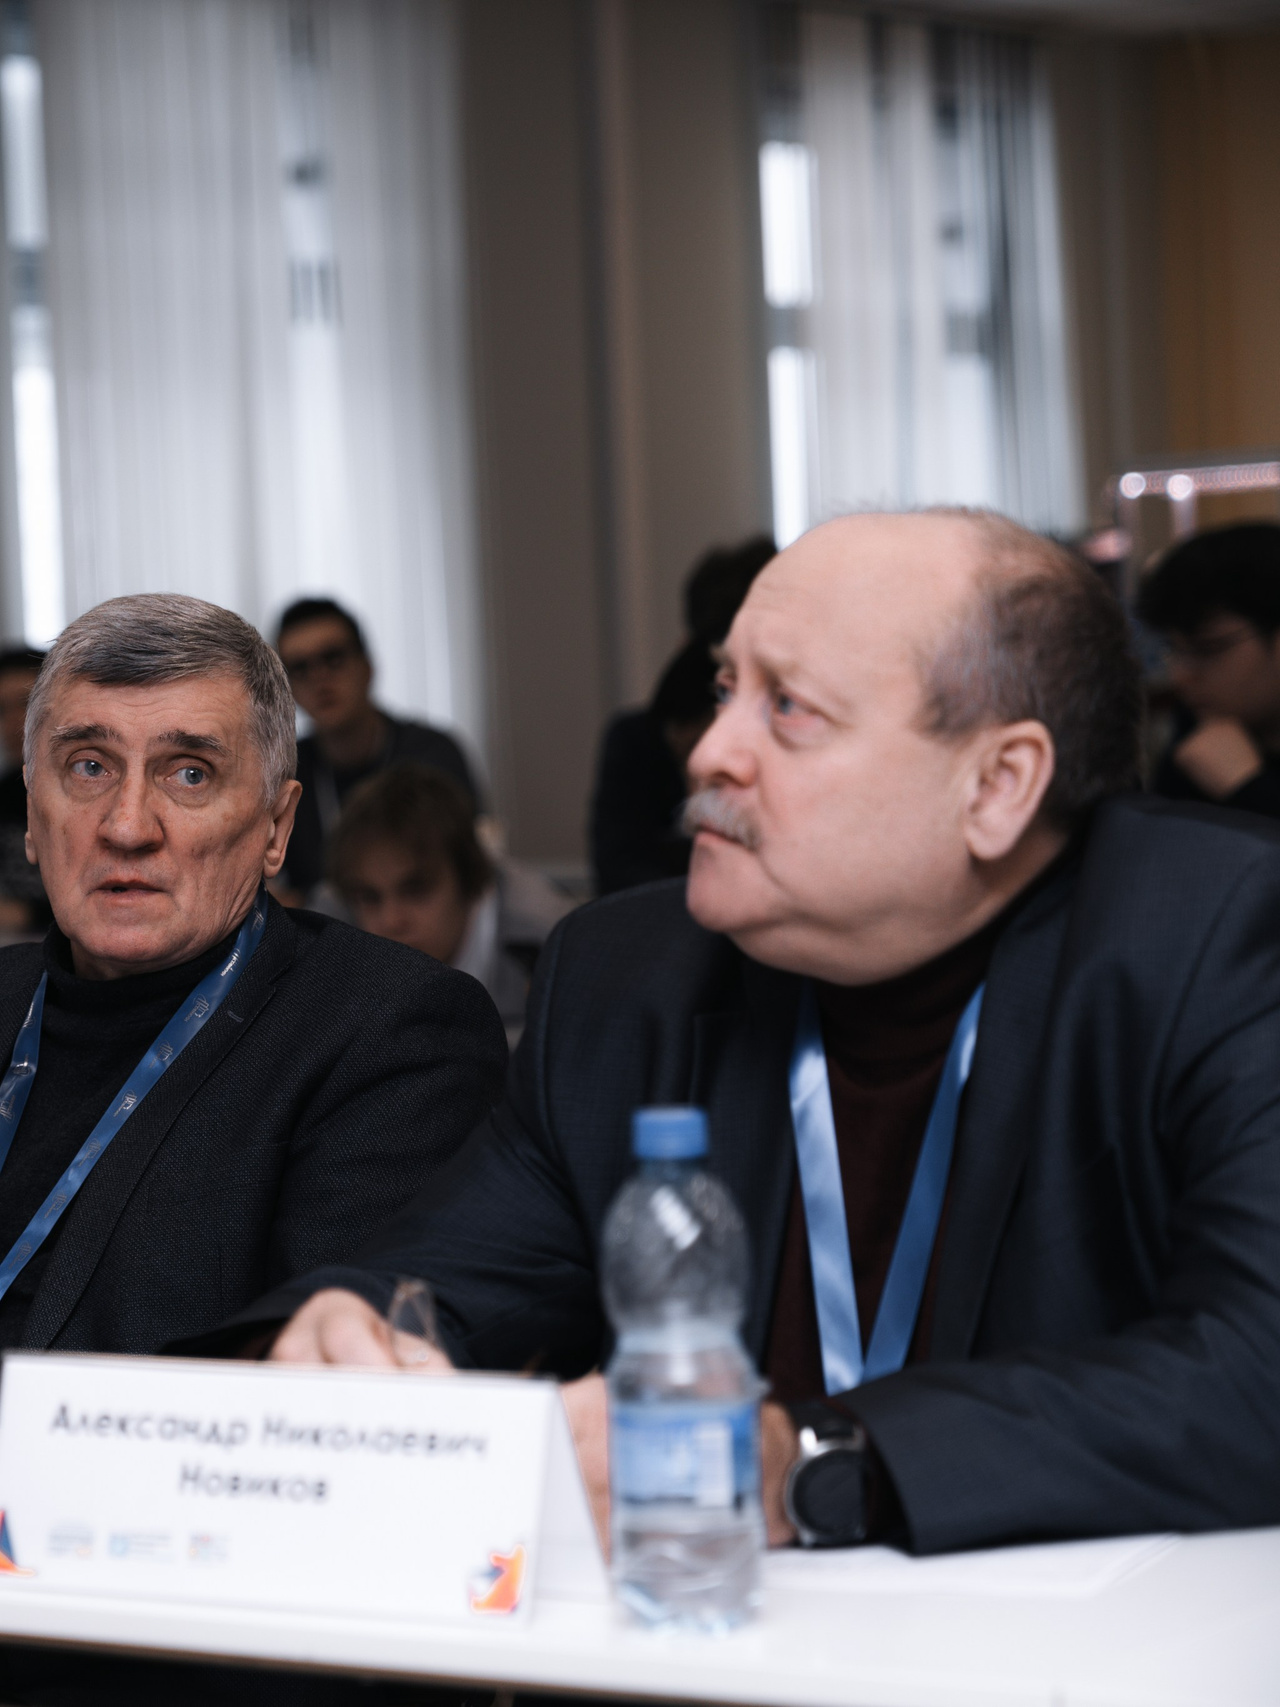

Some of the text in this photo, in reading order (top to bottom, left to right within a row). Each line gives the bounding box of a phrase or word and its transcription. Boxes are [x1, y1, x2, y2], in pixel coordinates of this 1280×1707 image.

[52, 1403, 487, 1459] Александр Николаевич
[179, 1464, 329, 1504] Новиков
